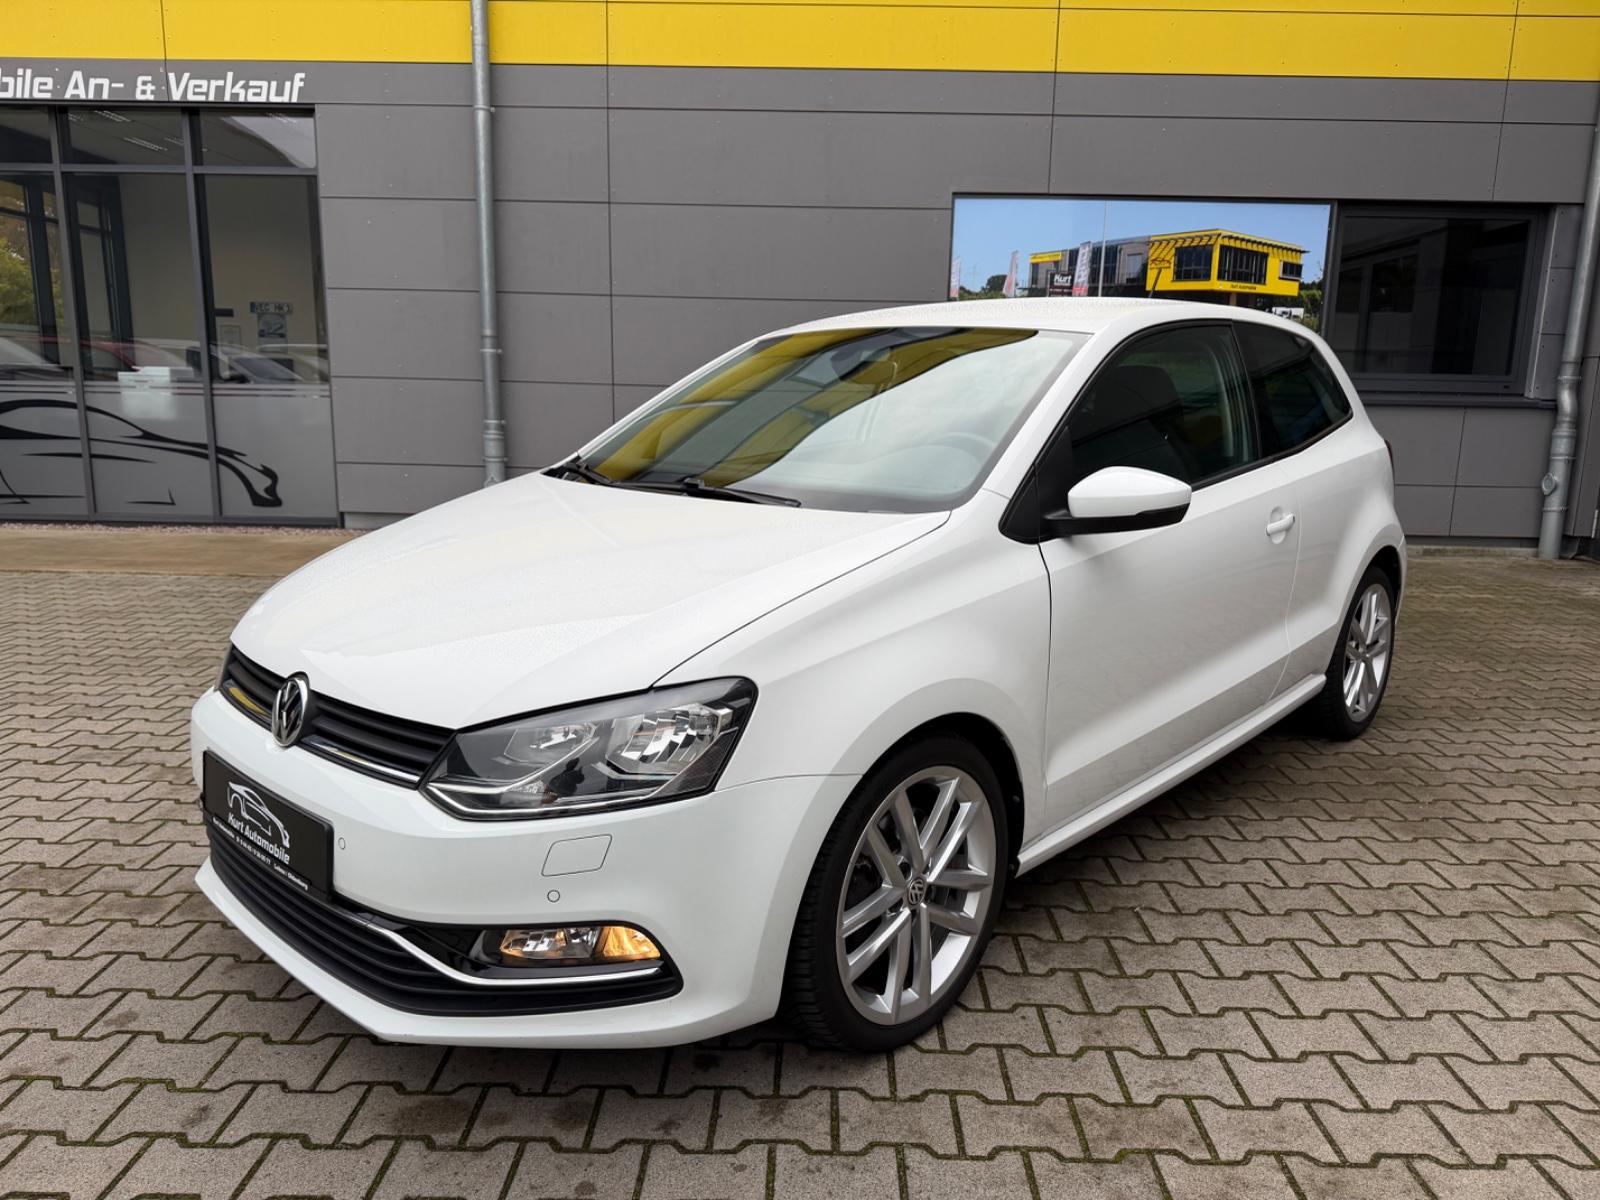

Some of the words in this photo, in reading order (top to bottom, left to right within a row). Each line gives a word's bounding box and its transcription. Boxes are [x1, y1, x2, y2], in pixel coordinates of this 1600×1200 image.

[64, 70, 125, 99] An-
[135, 75, 155, 100] &
[168, 71, 305, 103] Verkauf
[228, 812, 244, 833] Kurt
[245, 824, 290, 865] Automobile
